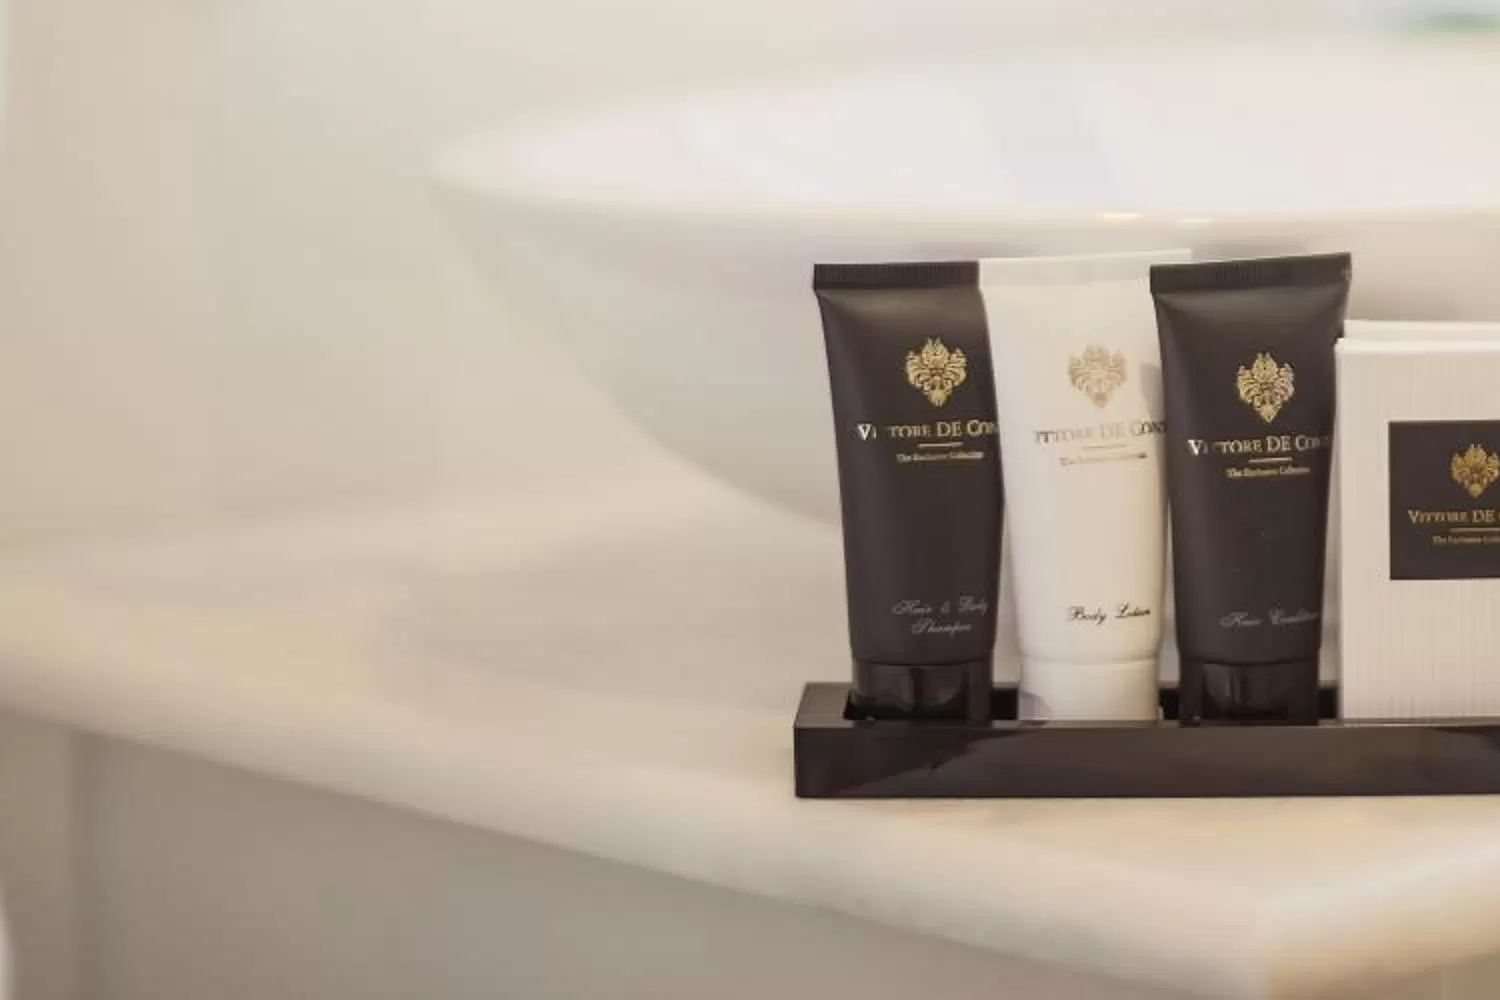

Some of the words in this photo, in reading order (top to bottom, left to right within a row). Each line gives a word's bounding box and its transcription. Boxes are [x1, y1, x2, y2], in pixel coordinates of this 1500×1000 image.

[936, 420, 963, 437] DE
[1266, 435, 1292, 453] DE
[1472, 508, 1496, 523] DE
[1065, 604, 1108, 626] Body
